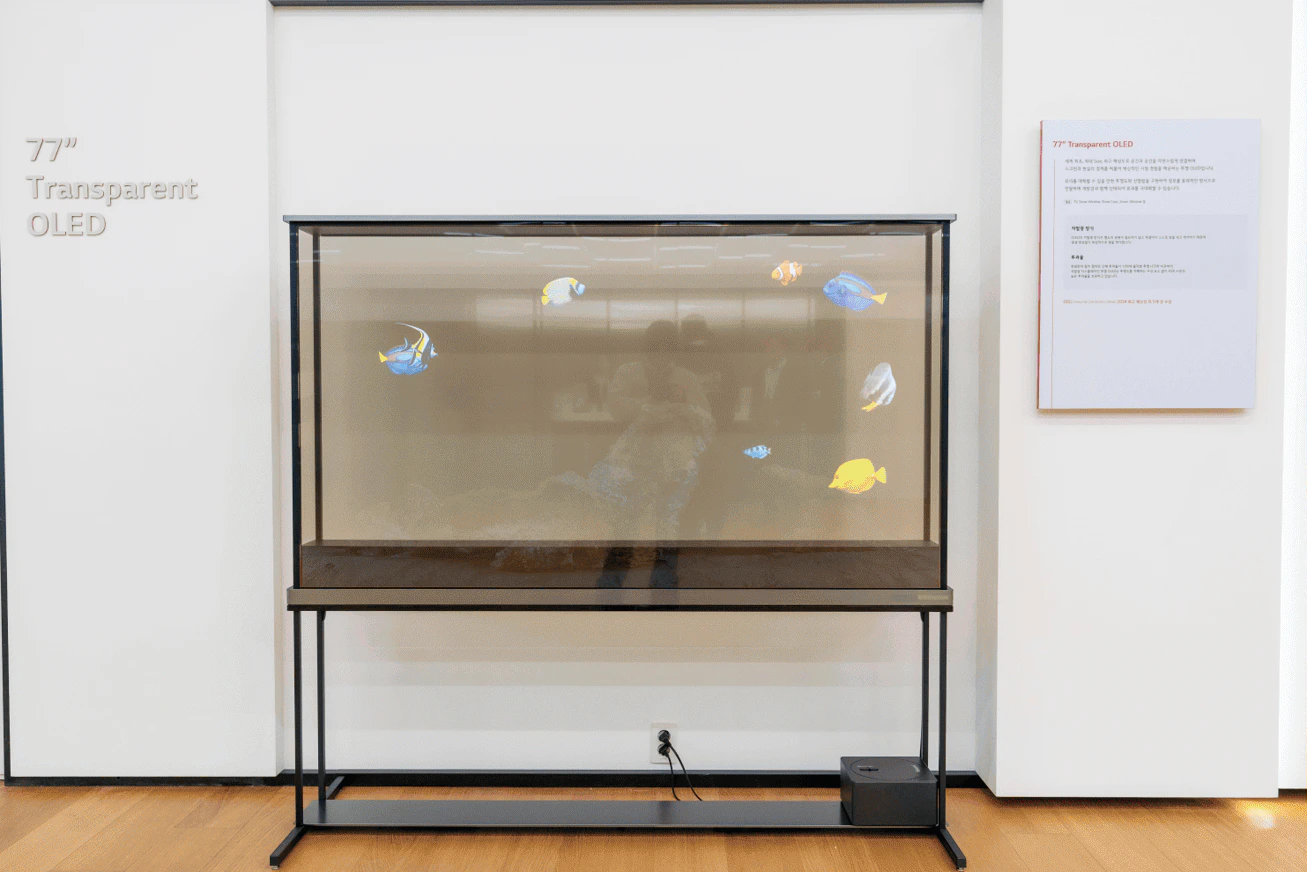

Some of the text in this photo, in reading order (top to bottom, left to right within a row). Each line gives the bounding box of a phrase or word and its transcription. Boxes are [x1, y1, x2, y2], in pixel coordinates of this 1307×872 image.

[1068, 141, 1111, 149] Transparent
[26, 175, 199, 206] Transparent
[27, 212, 107, 236] OLED
